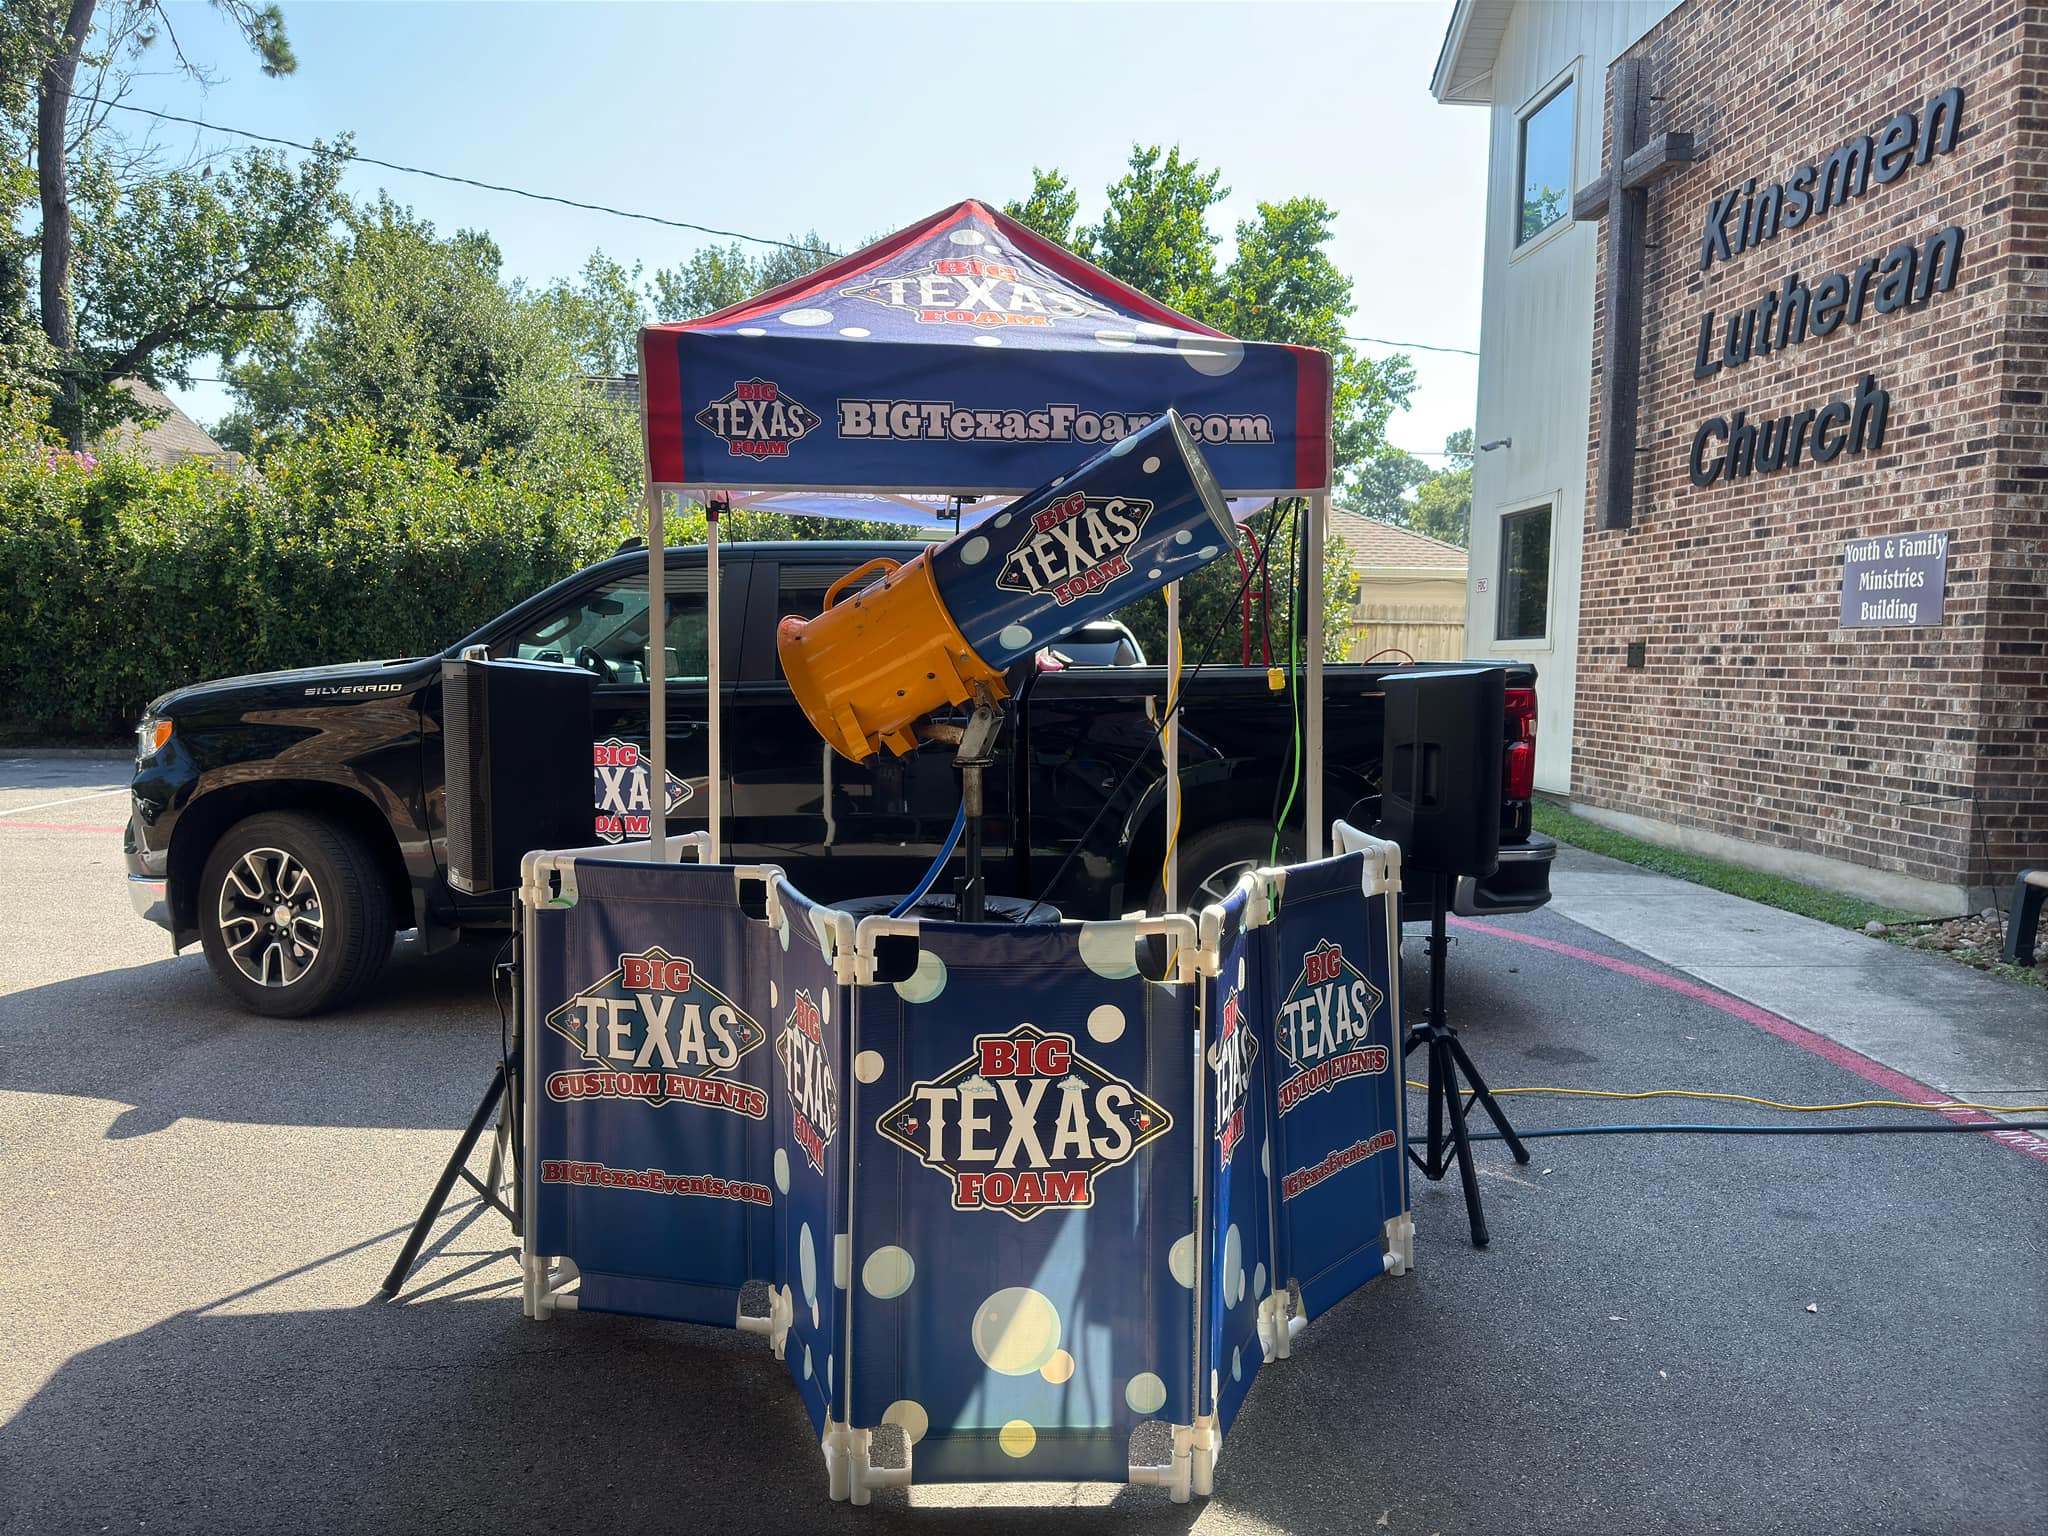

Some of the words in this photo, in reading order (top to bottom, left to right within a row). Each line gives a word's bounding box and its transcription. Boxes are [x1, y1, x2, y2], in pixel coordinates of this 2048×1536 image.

[1700, 86, 1964, 271] Kinsmen
[936, 258, 1017, 281] BIG
[920, 309, 1048, 327] FOAM
[1694, 227, 1964, 379] Lutheran
[737, 383, 777, 401] BIG
[711, 400, 805, 441] TEXAS
[1689, 374, 1890, 487] Church
[731, 441, 787, 456] FOAM
[1034, 494, 1086, 534] BIG
[1009, 500, 1138, 591] TEXAS
[1846, 541, 1880, 562] Youth
[1884, 540, 1895, 559] &
[1899, 534, 1947, 559] Family
[1054, 556, 1130, 604] FOAM
[1859, 567, 1925, 591] Ministries
[1861, 599, 1919, 624] Building
[305, 684, 402, 696] SILVERADO
[594, 746, 638, 767] BIG
[595, 816, 649, 833] OAM
[623, 959, 691, 991] BIG
[1306, 949, 1341, 985] BIG
[575, 994, 738, 1070] TEXAS
[796, 996, 820, 1044] BIG
[1284, 980, 1368, 1064] TEXAS
[979, 1039, 1070, 1076] BIG
[1331, 1050, 1385, 1080] EVENTS
[551, 1073, 660, 1098] CUSTOM
[665, 1075, 765, 1116] EVENTS
[786, 1024, 832, 1139] TEXAS
[794, 1109, 824, 1170] FOAM
[915, 1078, 1135, 1169] TEXAS
[543, 1162, 772, 1203] BIGTexasEvents.com
[958, 1173, 1088, 1204] FOAM
